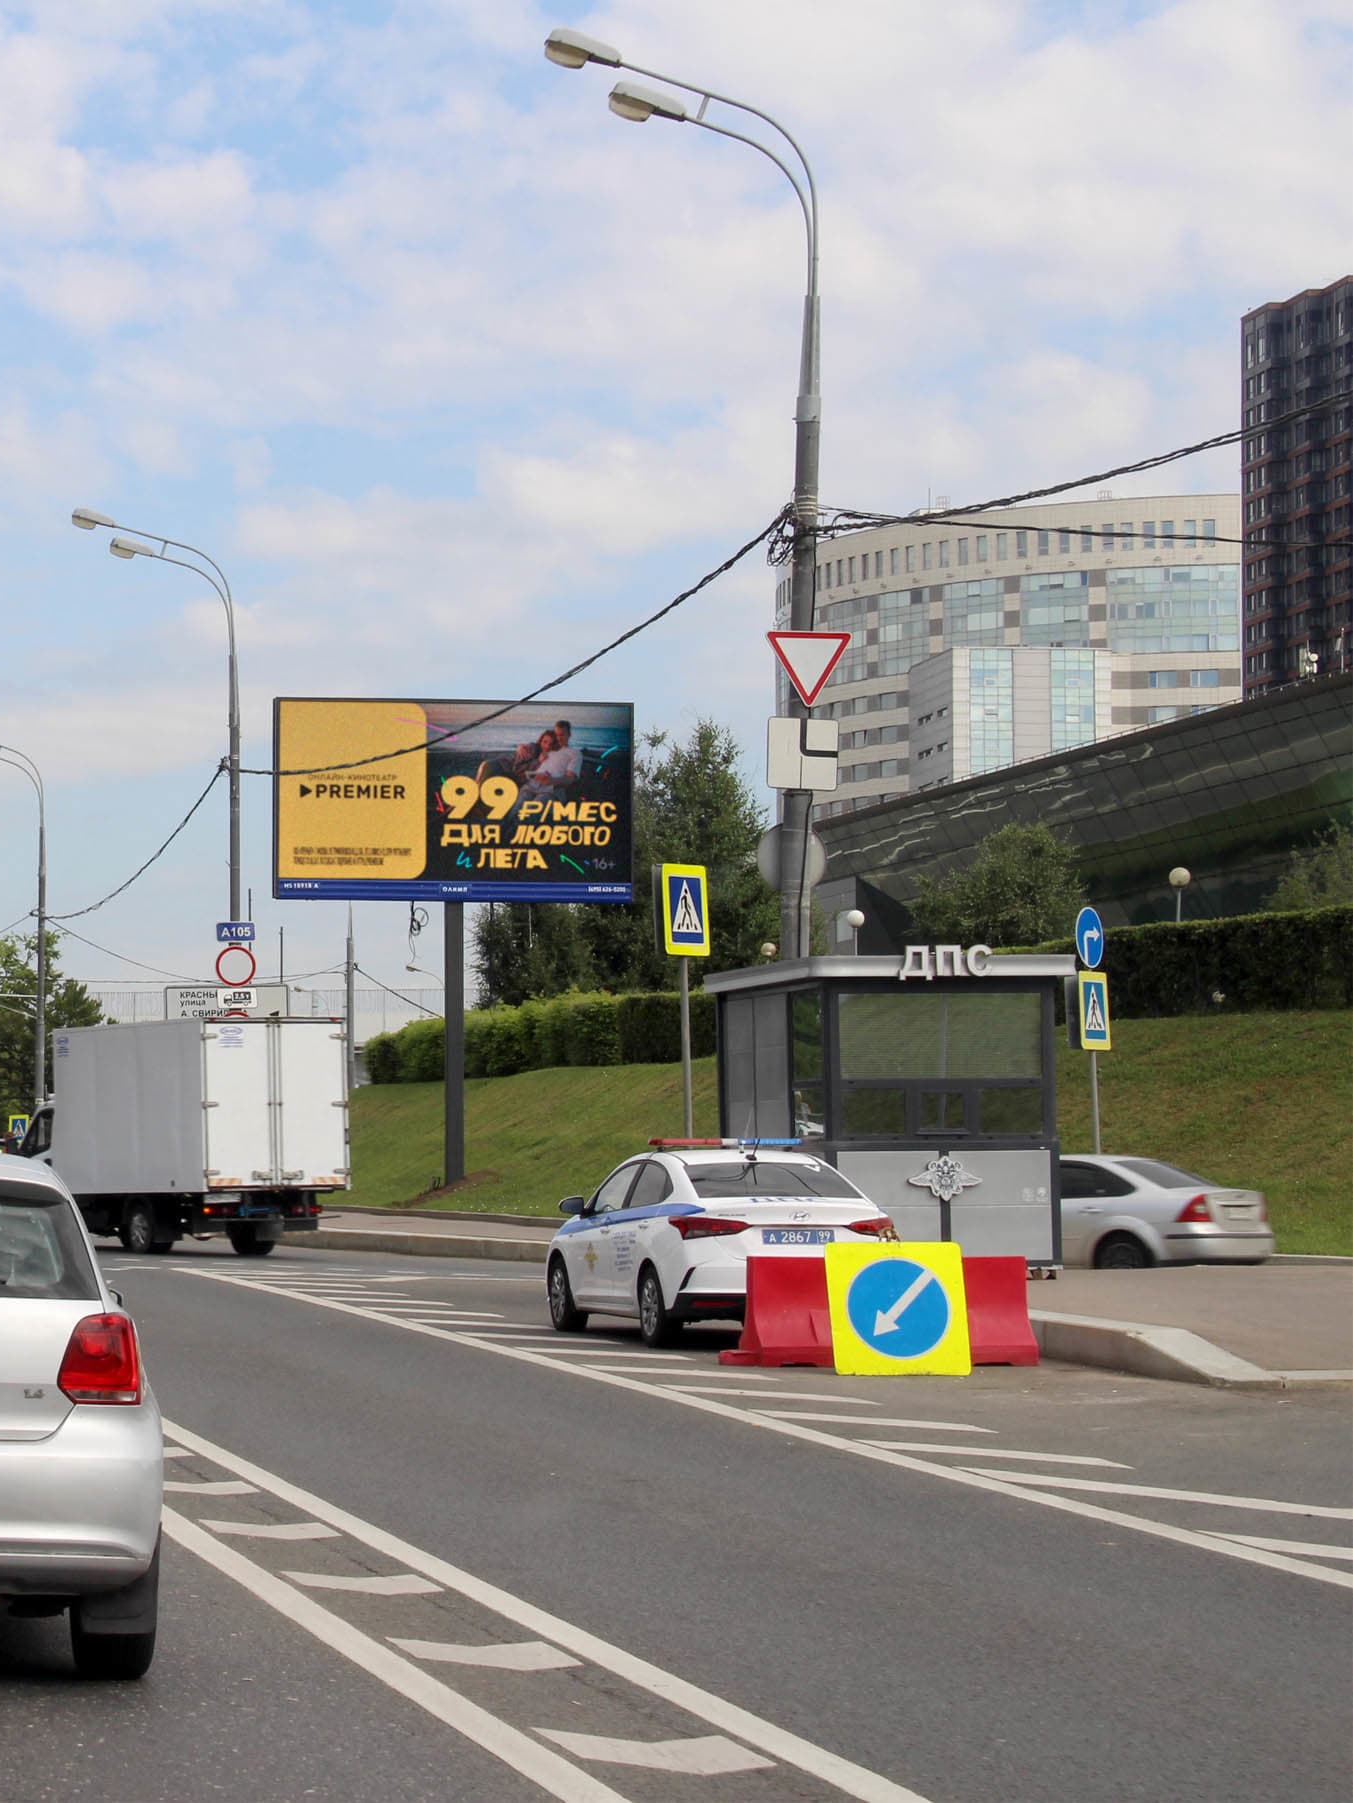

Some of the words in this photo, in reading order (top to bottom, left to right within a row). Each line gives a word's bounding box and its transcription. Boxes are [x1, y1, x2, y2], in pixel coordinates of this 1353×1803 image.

[315, 784, 405, 799] PREMIER
[441, 775, 519, 819] 99
[440, 824, 500, 846] ДЛЯ
[511, 825, 611, 846] ЛЮБОГО
[477, 848, 548, 869] ЛЕТА
[593, 858, 616, 870] 16+
[899, 944, 992, 980] ДПС
[179, 991, 218, 999] КРАСНЫ
[781, 1231, 811, 1243] 2867
[818, 1231, 830, 1240] 99
